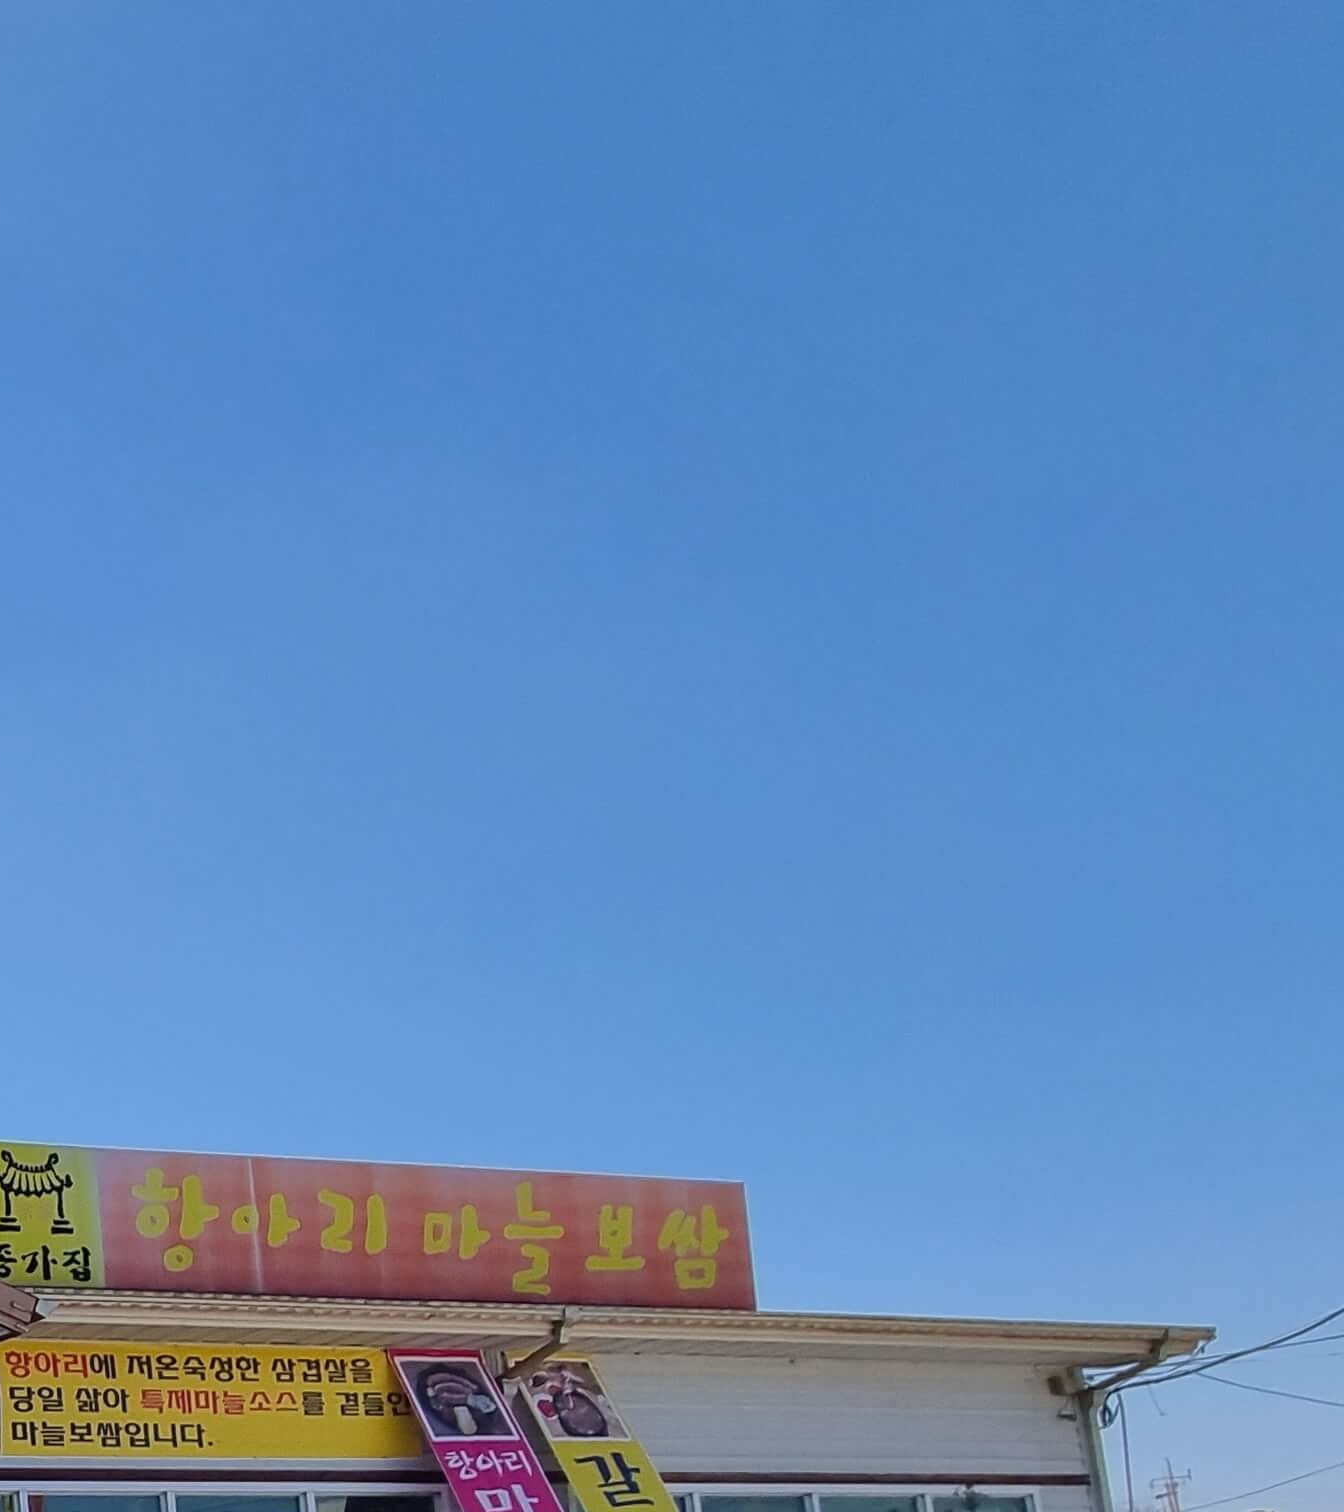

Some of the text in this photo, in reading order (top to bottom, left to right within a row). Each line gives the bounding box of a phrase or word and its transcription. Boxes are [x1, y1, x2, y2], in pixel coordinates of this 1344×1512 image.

[130, 1168, 730, 1295] 항아리 마늘보쌈
[5, 1350, 372, 1384] 항아리에 저온숙성한 삼겹살을
[9, 1386, 64, 1413] 당일
[75, 1387, 130, 1414] 삶아
[140, 1388, 325, 1417] 특제마늘소스를
[11, 1420, 214, 1449] 마늘보쌈입니다.
[445, 1449, 533, 1481] 항아리
